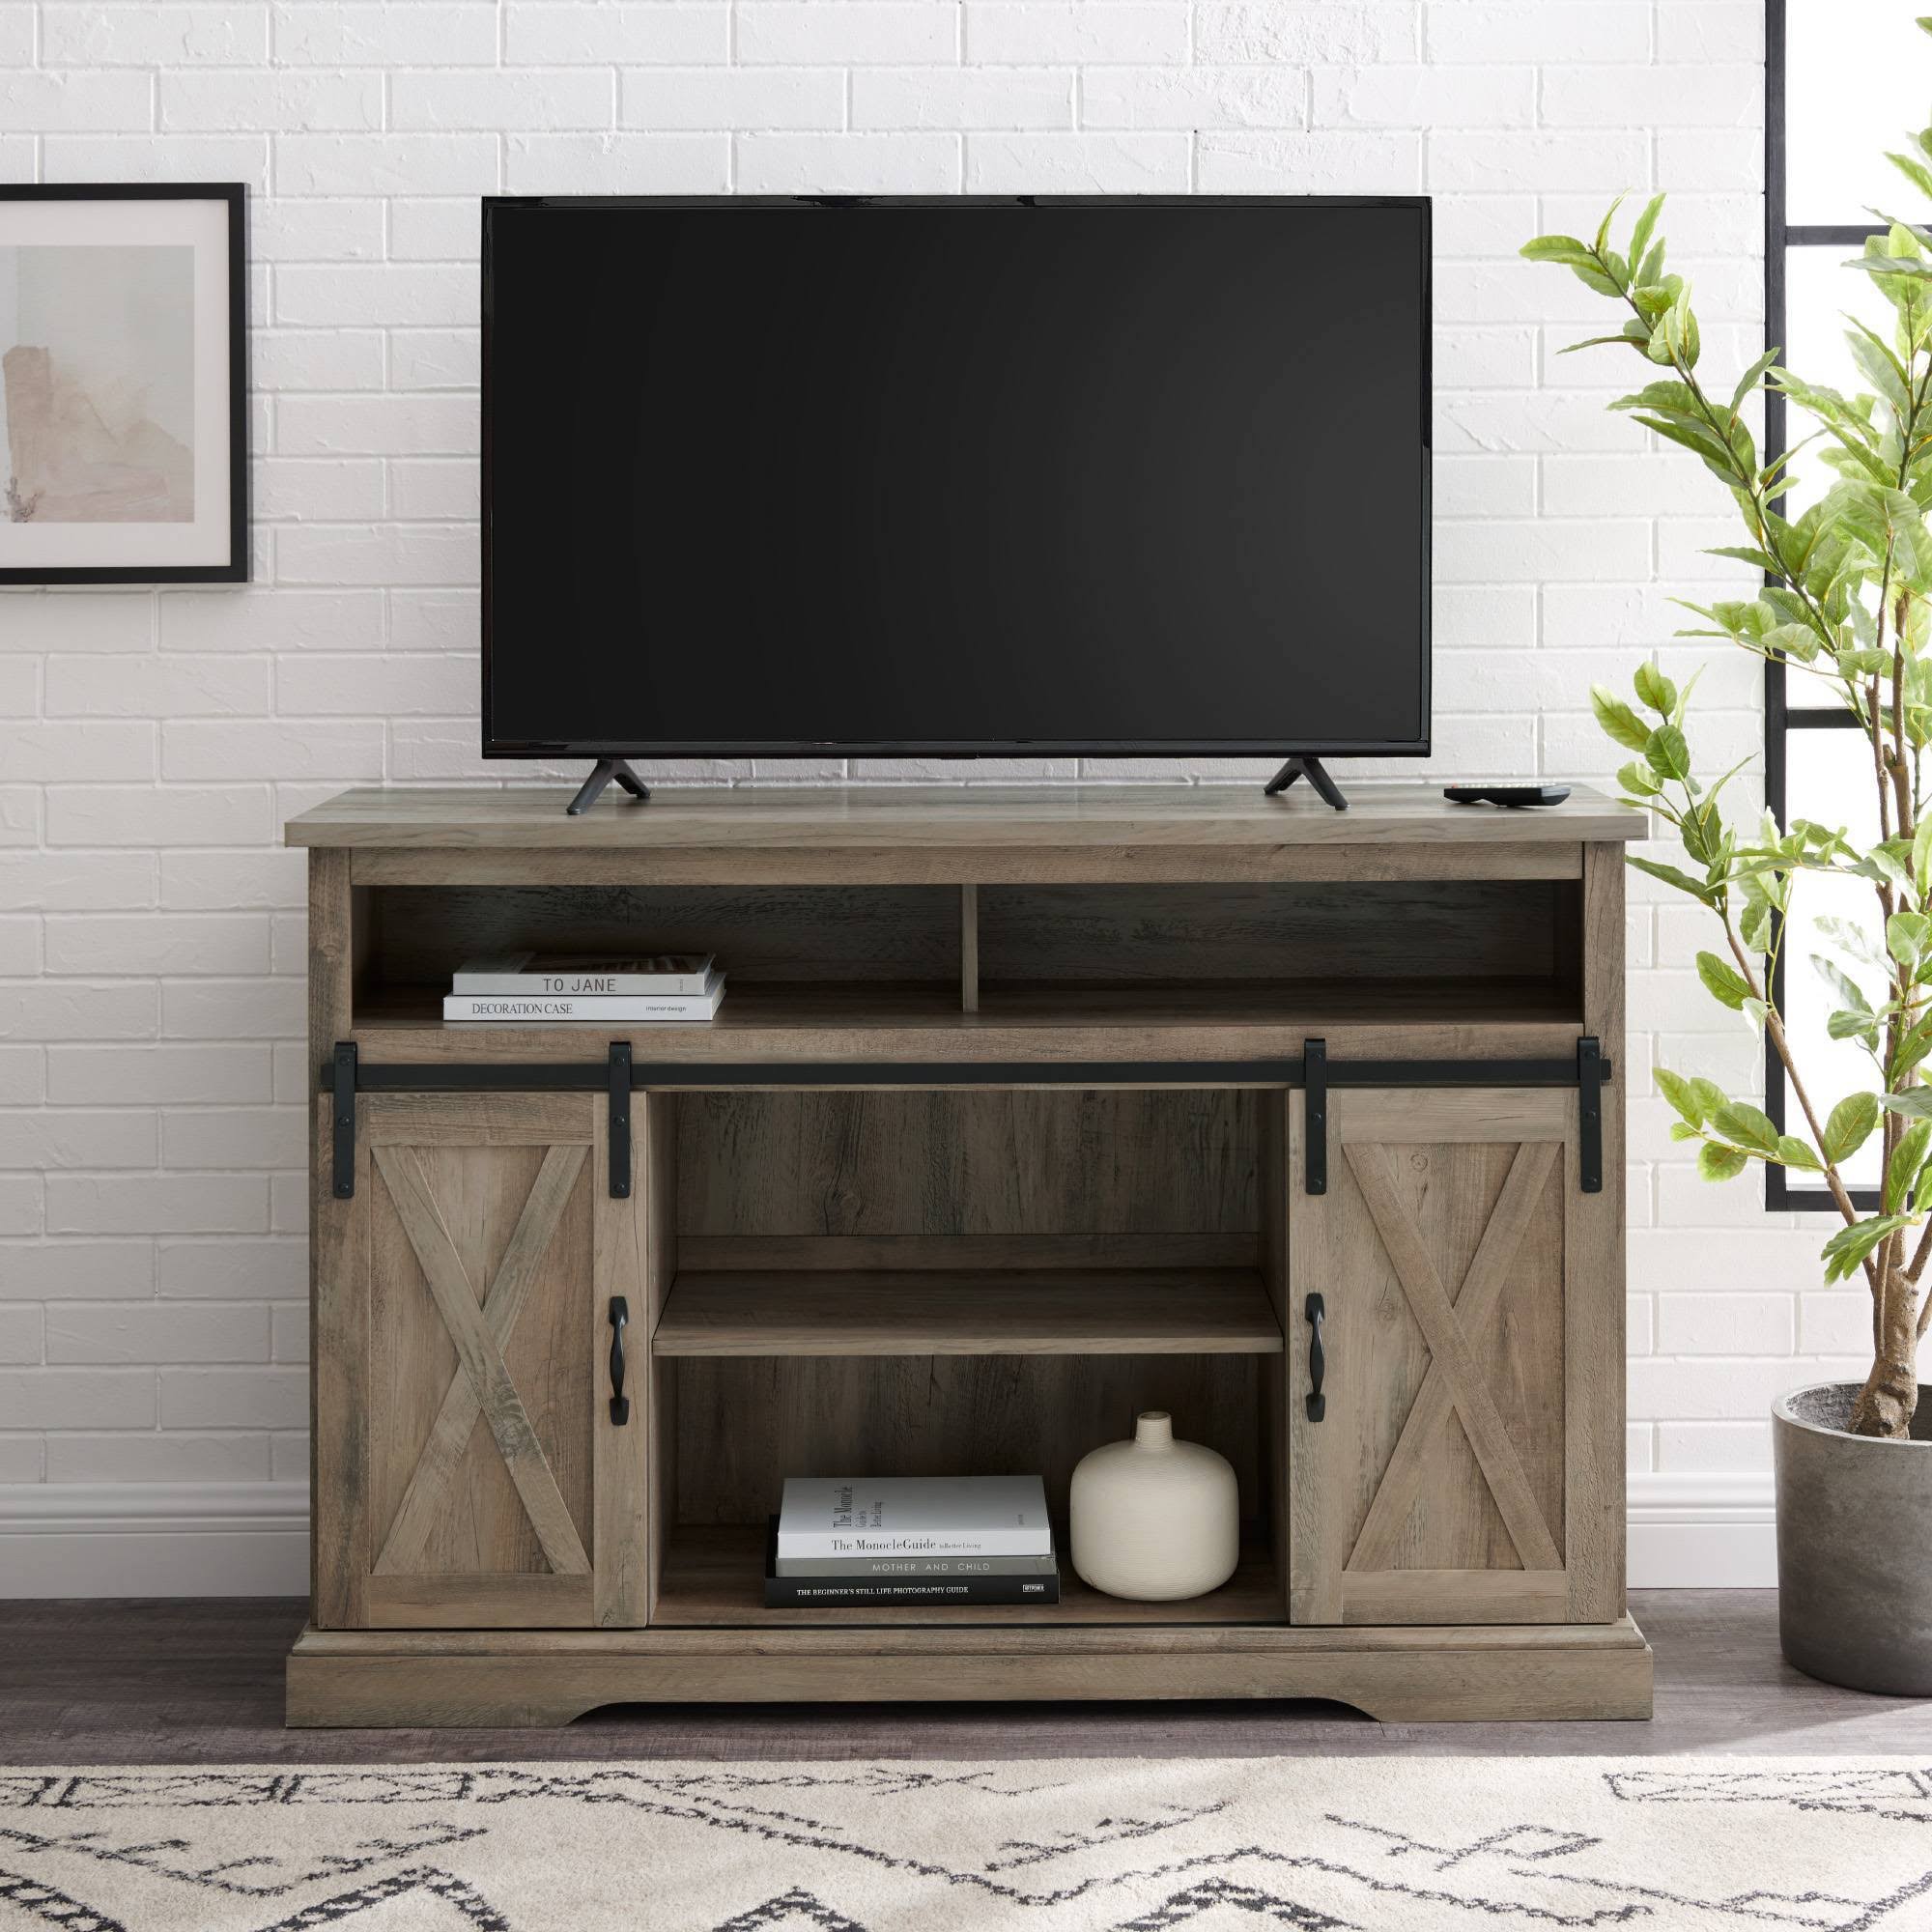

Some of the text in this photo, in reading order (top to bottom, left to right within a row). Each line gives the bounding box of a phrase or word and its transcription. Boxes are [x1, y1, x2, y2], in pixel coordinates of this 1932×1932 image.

[543, 979, 616, 991] TO JANE
[472, 1003, 573, 1014] DECORATION CASE
[832, 1540, 853, 1551] The
[872, 1562, 990, 1572] MOTHER AND CHILD
